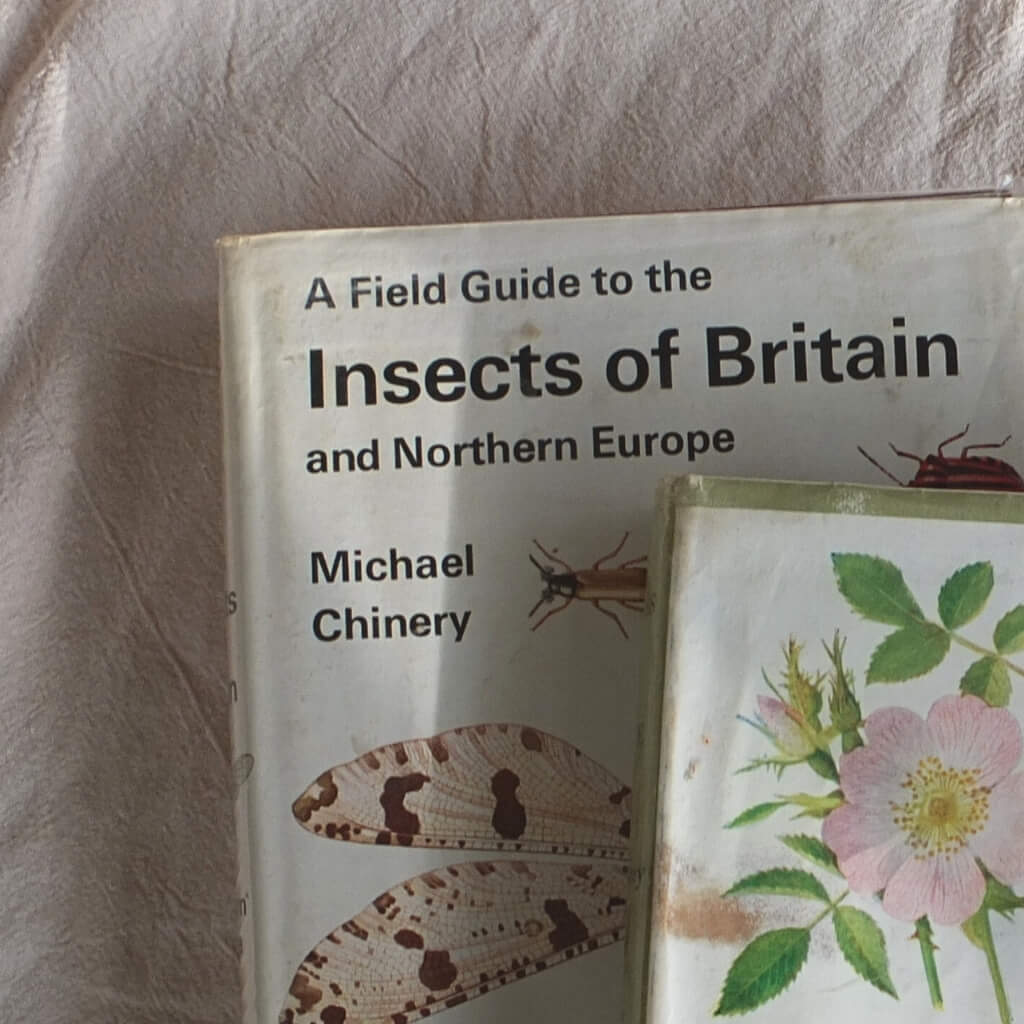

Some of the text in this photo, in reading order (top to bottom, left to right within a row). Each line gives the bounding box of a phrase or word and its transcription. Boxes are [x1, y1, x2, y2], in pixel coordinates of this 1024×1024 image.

[305, 260, 711, 310] A Field Guide to the
[310, 317, 958, 408] Insects of Britain
[307, 425, 734, 473] and Northern Europe
[311, 544, 473, 584] Michael
[313, 606, 471, 642] Chinery
